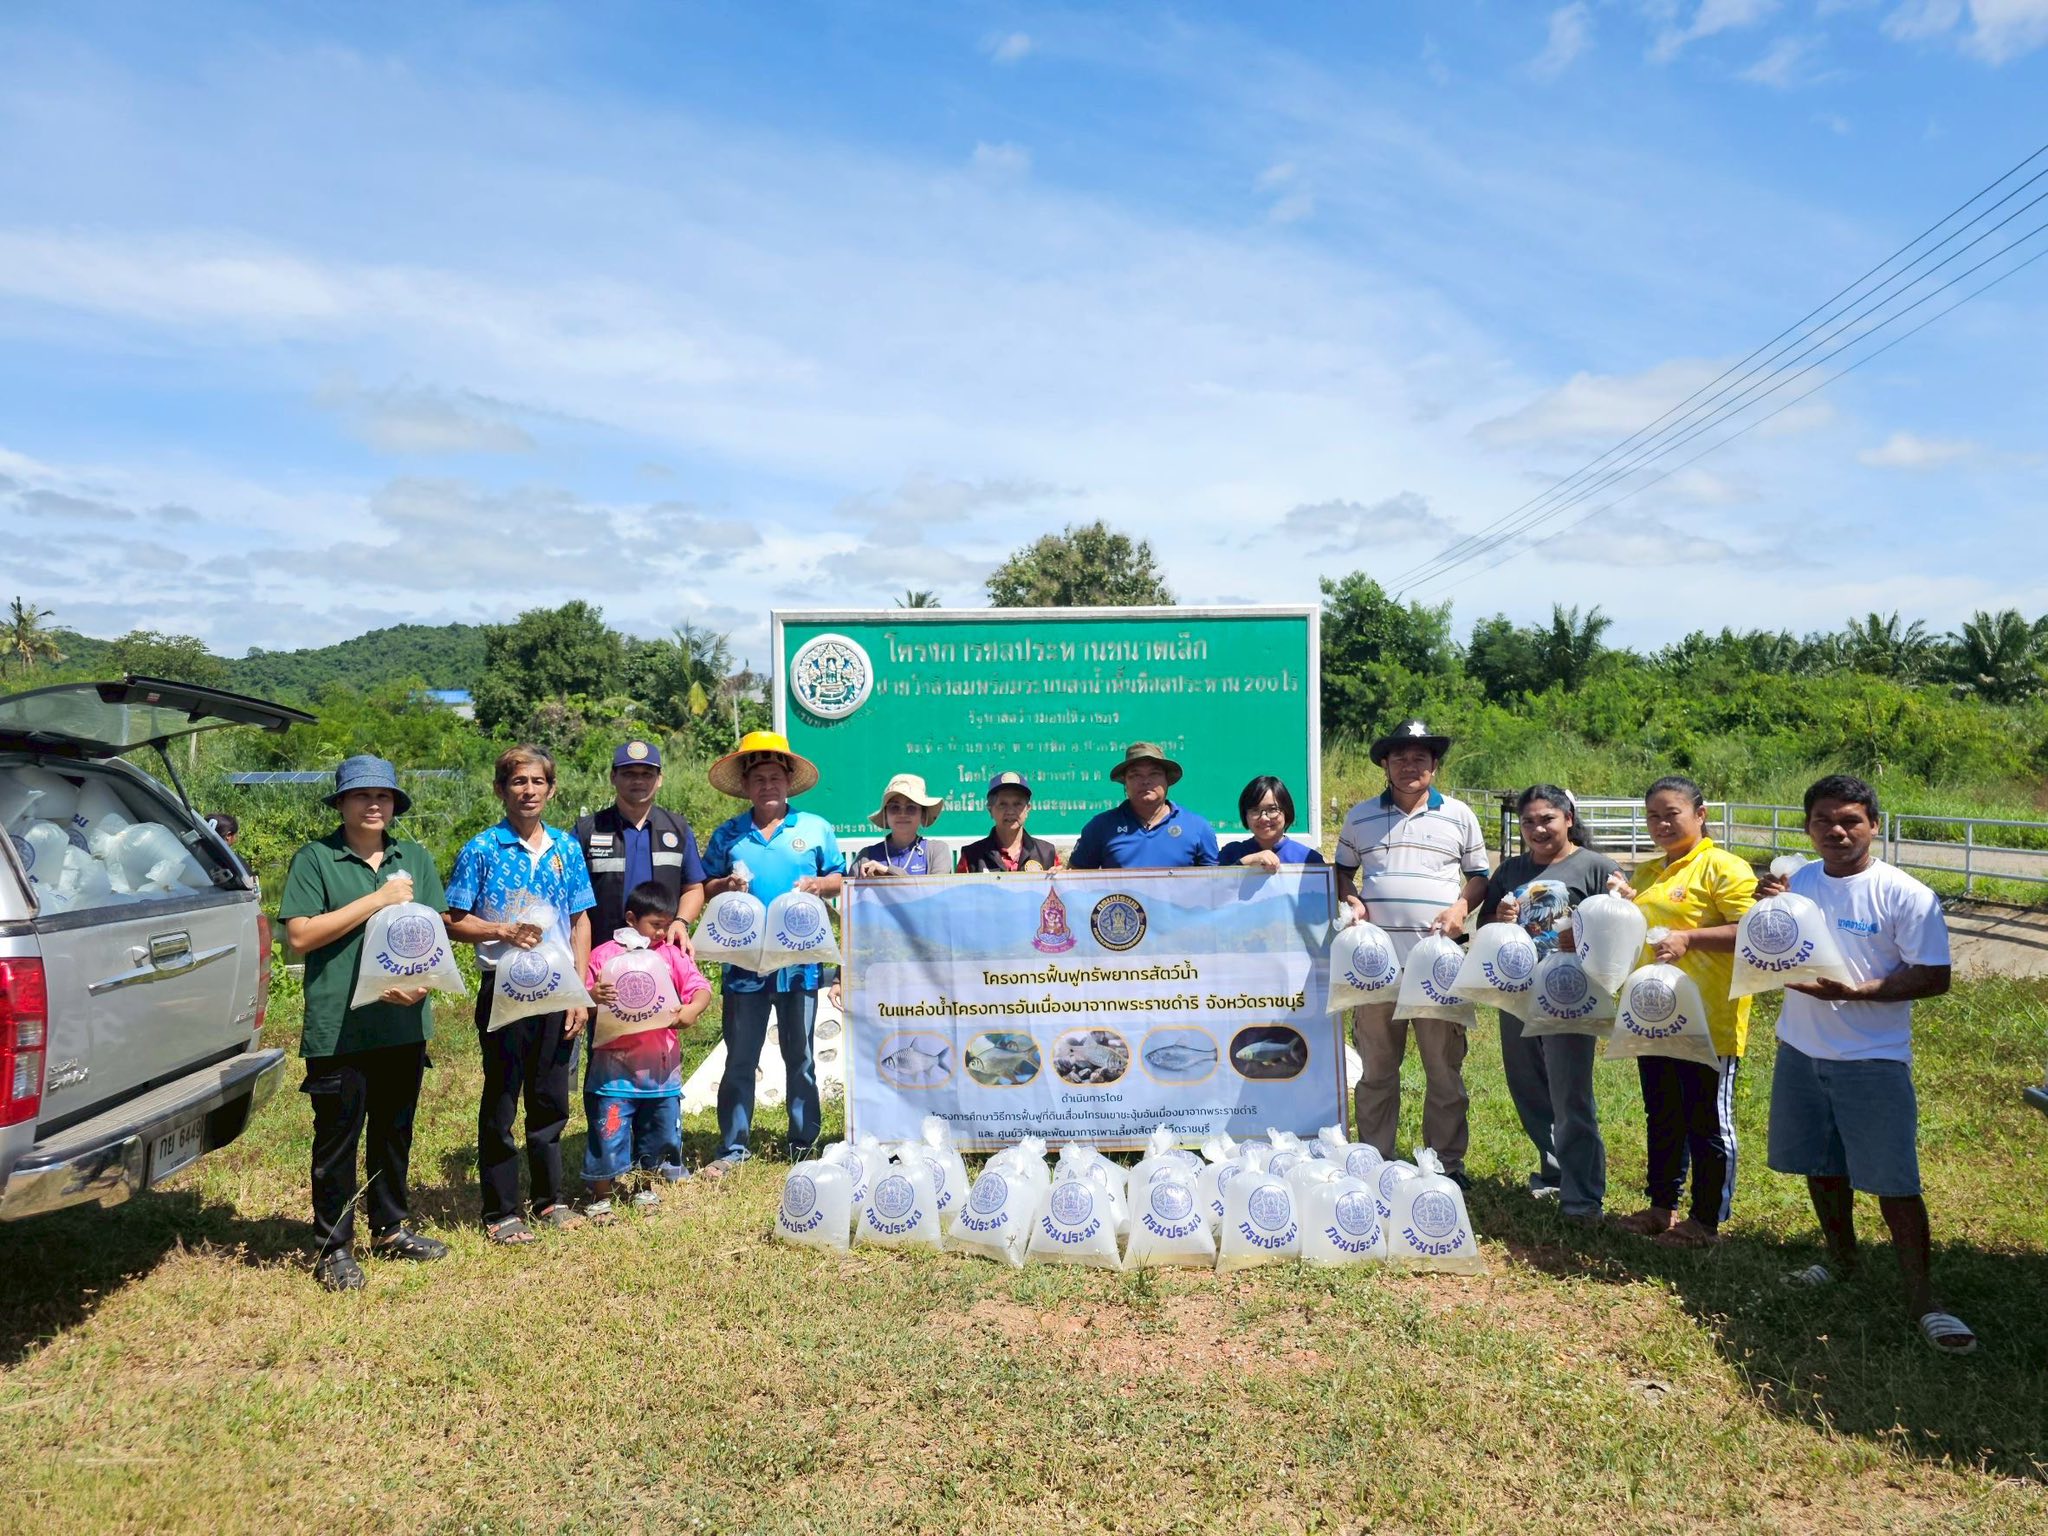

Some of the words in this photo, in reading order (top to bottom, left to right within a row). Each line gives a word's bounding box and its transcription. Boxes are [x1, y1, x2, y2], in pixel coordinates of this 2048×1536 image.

[706, 921, 757, 948] กรมประมง
[776, 927, 827, 951] กรมประมง
[376, 946, 444, 976] กรมประมง
[1741, 940, 1814, 972] กรมประมง
[501, 972, 562, 1002] กรมประมง
[983, 960, 1198, 987] โครงการฟื้นฟูทรัพยากรสัตว์น้ำ
[1344, 966, 1396, 991] กรมประมง
[1482, 961, 1533, 992] กรมประมง
[878, 993, 1199, 1017] ในแหล่งน้ำโครงการอันเนื่องมาจากพระราชดำริ
[1206, 992, 1305, 1012] จังหวัดราชบุรี
[1420, 979, 1463, 1005] กรมประ
[609, 995, 665, 1023] กรมประมง
[1538, 995, 1598, 1019] กรมประมง
[1622, 1011, 1688, 1039] กรมประมง
[1061, 1092, 1123, 1103] ดำเนินการโดย
[978, 1130, 994, 1138] และ
[865, 1207, 922, 1234] กรมประมง
[960, 1203, 1009, 1231] กรมประมง
[1042, 1215, 1101, 1244] กรมประมง
[1142, 1213, 1201, 1239] กรมประมง
[1239, 1221, 1298, 1249] กรมประมง
[1325, 1224, 1381, 1253] กรมประมง
[1403, 1226, 1466, 1255] กรมประมง
